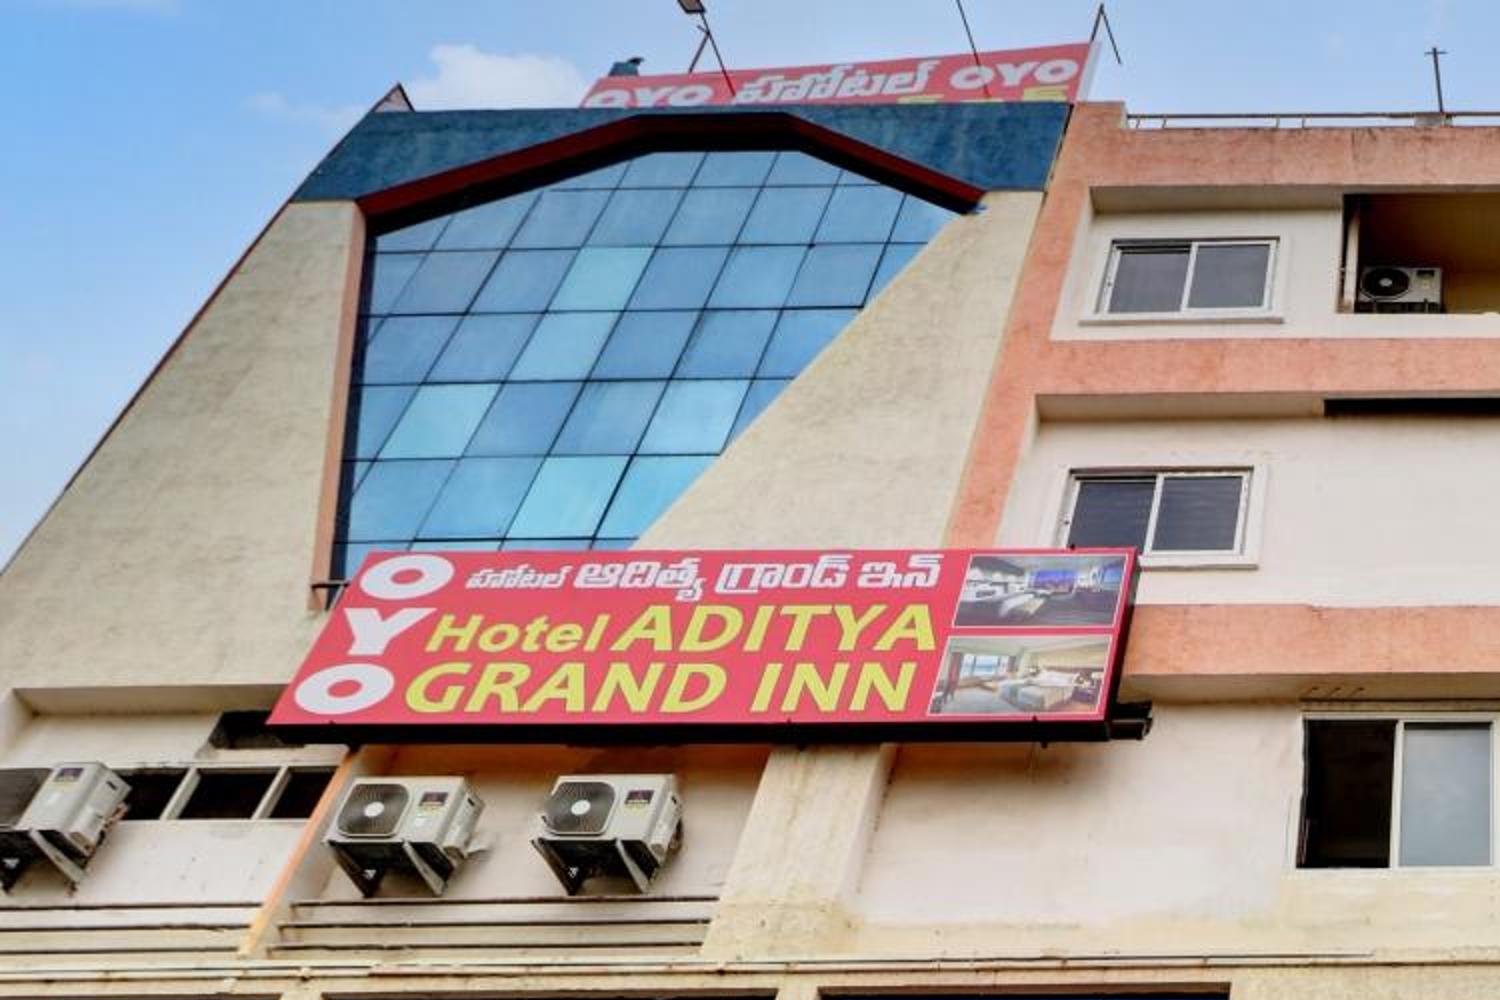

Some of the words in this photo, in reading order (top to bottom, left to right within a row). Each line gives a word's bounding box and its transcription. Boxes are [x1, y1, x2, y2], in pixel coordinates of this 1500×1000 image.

[584, 84, 714, 107] OYO
[950, 59, 1078, 91] OYO
[573, 556, 706, 602] ఆదిత్య
[715, 554, 853, 594] గ్రాండ్
[857, 553, 944, 588] ఇన్
[424, 613, 612, 655] Hotel
[611, 604, 937, 653] ADITYA
[404, 662, 727, 716] GRAND
[750, 663, 915, 714] INN
